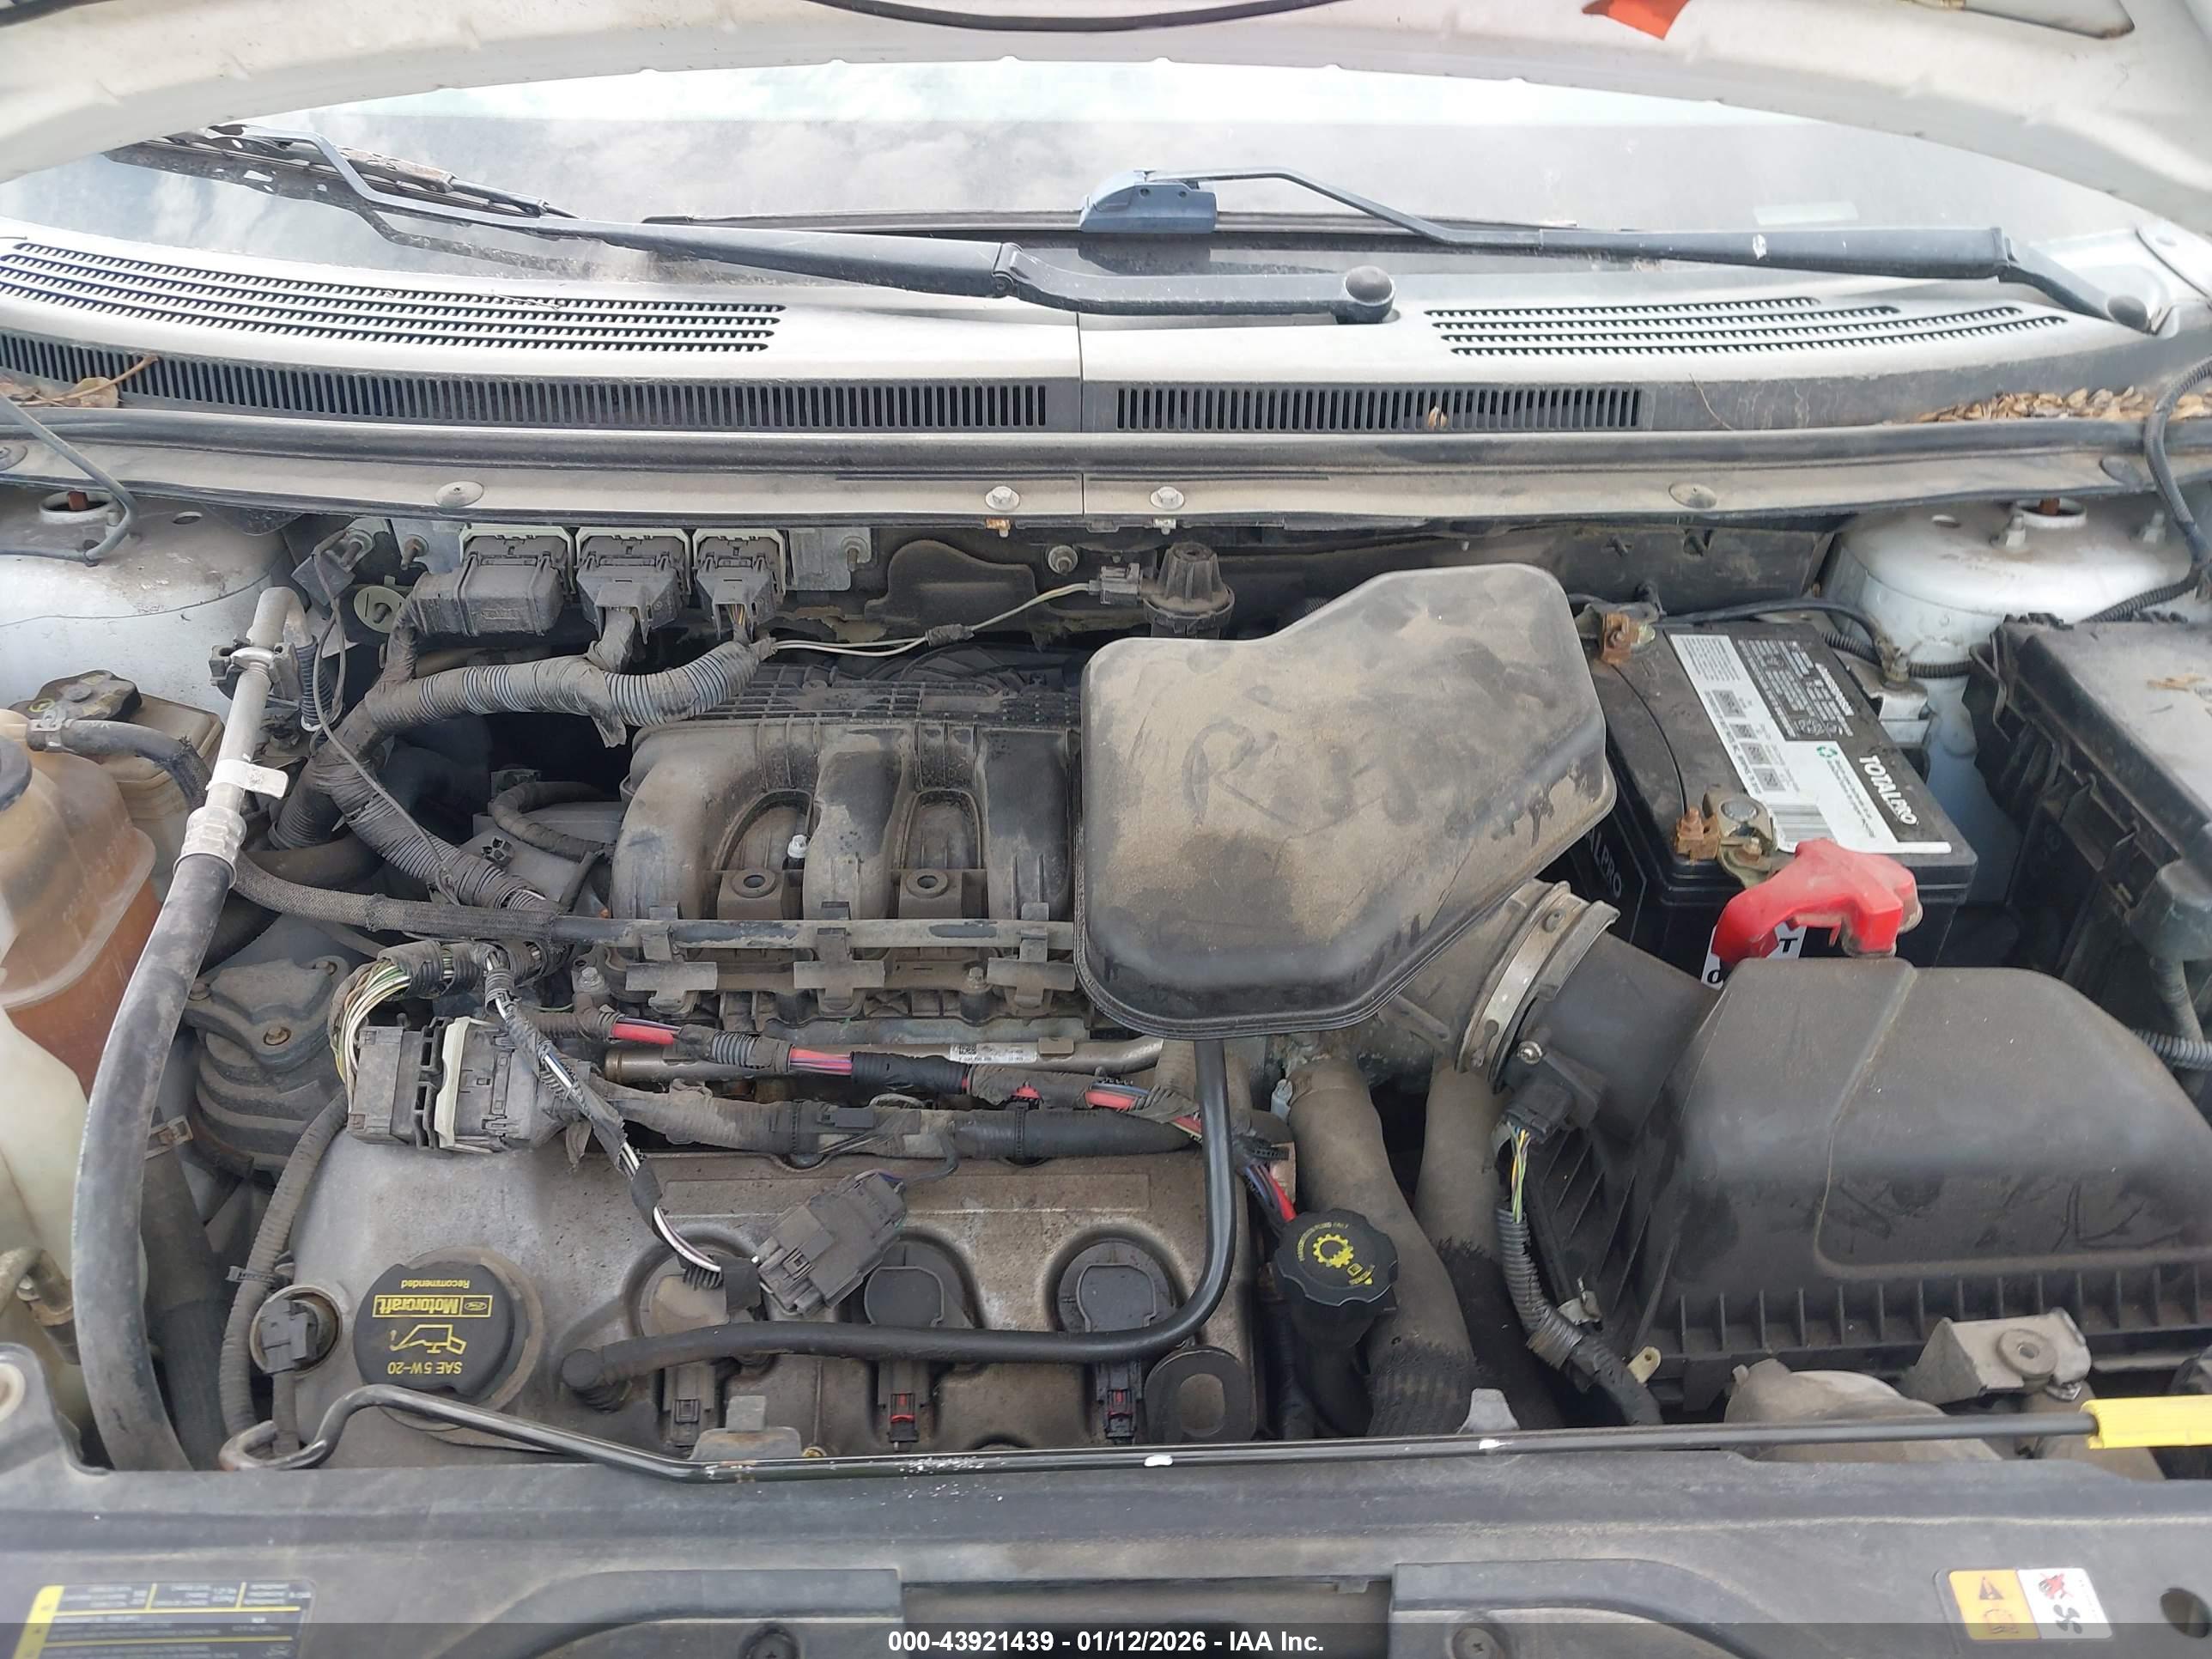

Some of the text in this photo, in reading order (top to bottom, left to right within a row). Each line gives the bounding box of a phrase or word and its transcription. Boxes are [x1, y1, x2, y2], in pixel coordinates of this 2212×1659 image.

[1859, 755, 1917, 825] TOTALPRO
[1585, 827, 1622, 898] ALPRO
[401, 1279, 471, 1289] Recommended
[379, 1298, 459, 1314] Motorcraft
[389, 1362, 463, 1375] SAE 5W-20
